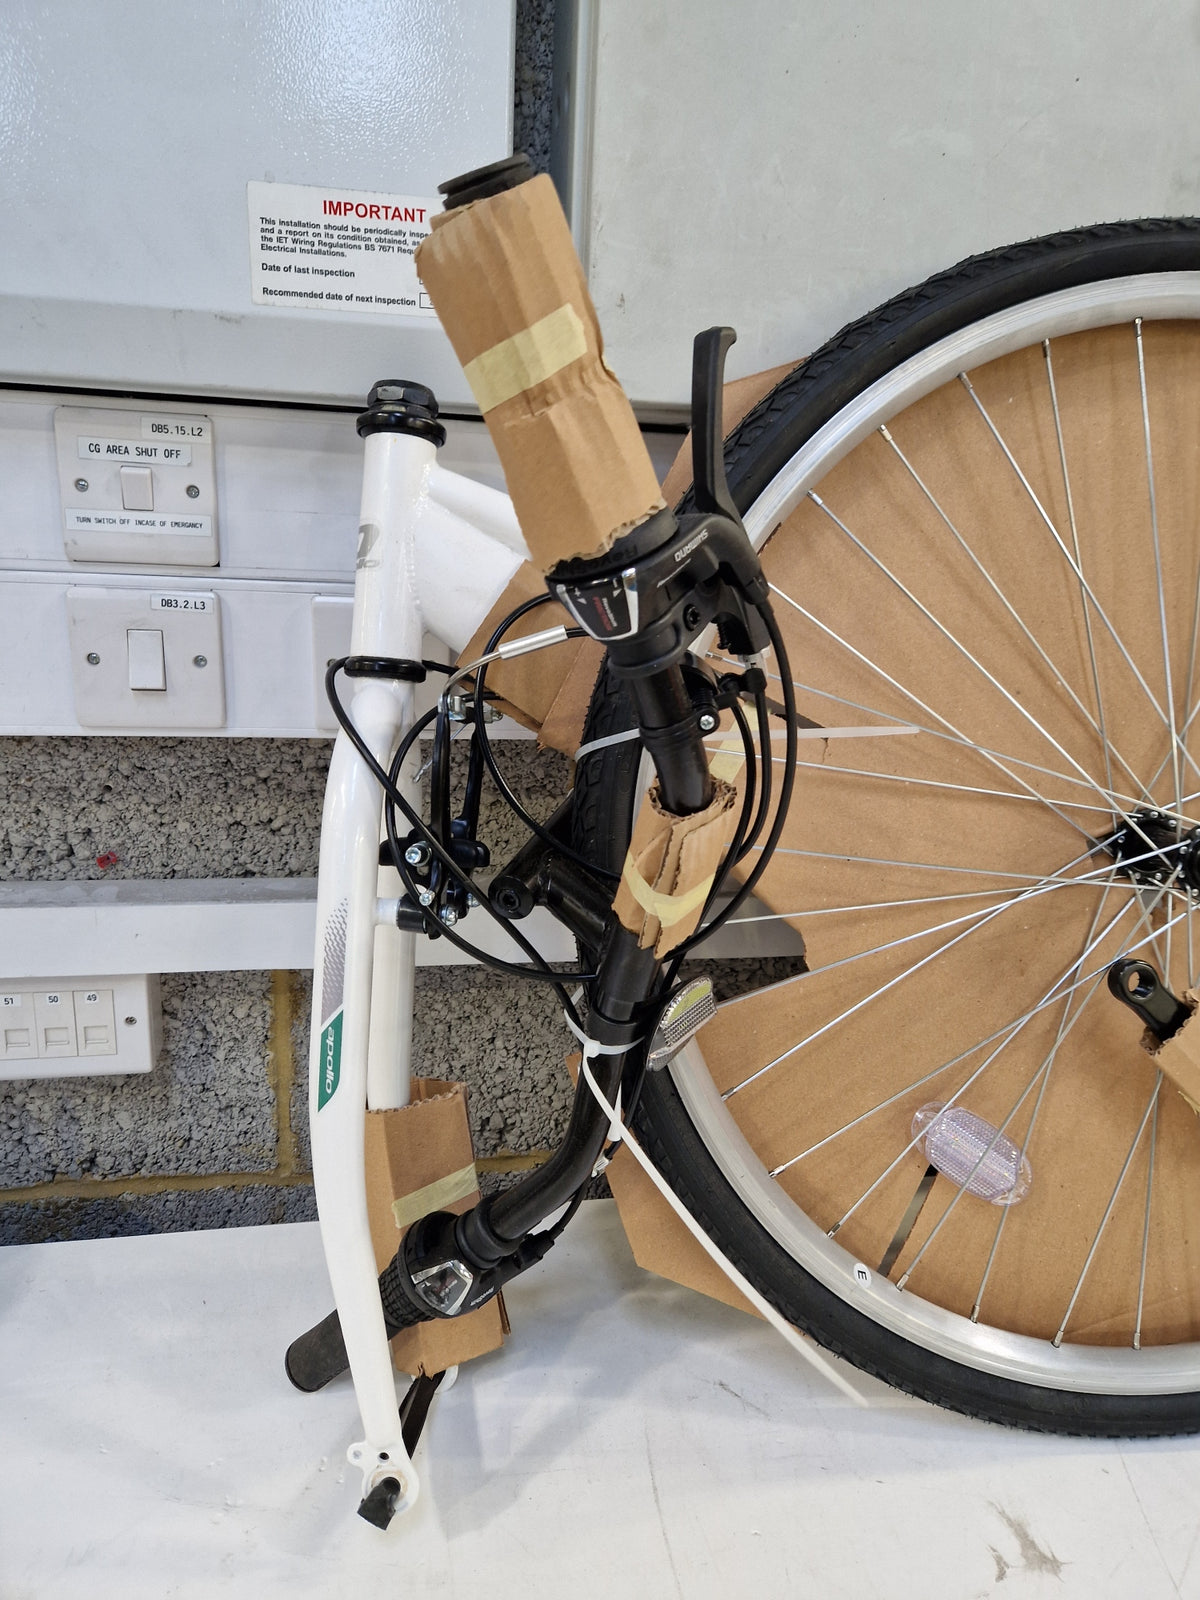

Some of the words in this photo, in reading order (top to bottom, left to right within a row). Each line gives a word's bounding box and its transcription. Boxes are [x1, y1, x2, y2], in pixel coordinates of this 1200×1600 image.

[323, 200, 426, 223] IMPORTANT
[260, 217, 276, 226] This
[278, 218, 321, 230] installation
[324, 224, 349, 232] should
[364, 226, 407, 238] periodically
[409, 230, 431, 239] inspe
[276, 236, 288, 244] IET
[292, 237, 315, 247] Wiring
[318, 240, 362, 250] Regulations
[378, 244, 395, 252] 7671
[285, 229, 309, 238] report
[337, 233, 372, 242] condition
[374, 236, 409, 246] obtained,
[260, 244, 296, 253] Electrical
[299, 247, 348, 258] Installations.
[262, 263, 281, 272] Date
[283, 264, 292, 272] of
[294, 266, 310, 274] last
[312, 267, 355, 278] inspection
[262, 287, 324, 300] Recommended
[326, 292, 343, 301] date
[345, 294, 354, 302] of
[356, 295, 373, 303] next
[374, 296, 416, 306] inspection
[151, 423, 203, 437] DB5.15.L2
[88, 443, 100, 454] CG
[106, 446, 130, 456] AREA
[136, 447, 158, 458] SHUT
[164, 449, 181, 459] OFF
[674, 528, 709, 562] SHIMANO
[161, 598, 206, 610] DB3.2.L3
[4, 997, 14, 1005] 51
[48, 995, 59, 1004] 50
[86, 994, 98, 1002] 49
[326, 1026, 335, 1094] apollo
